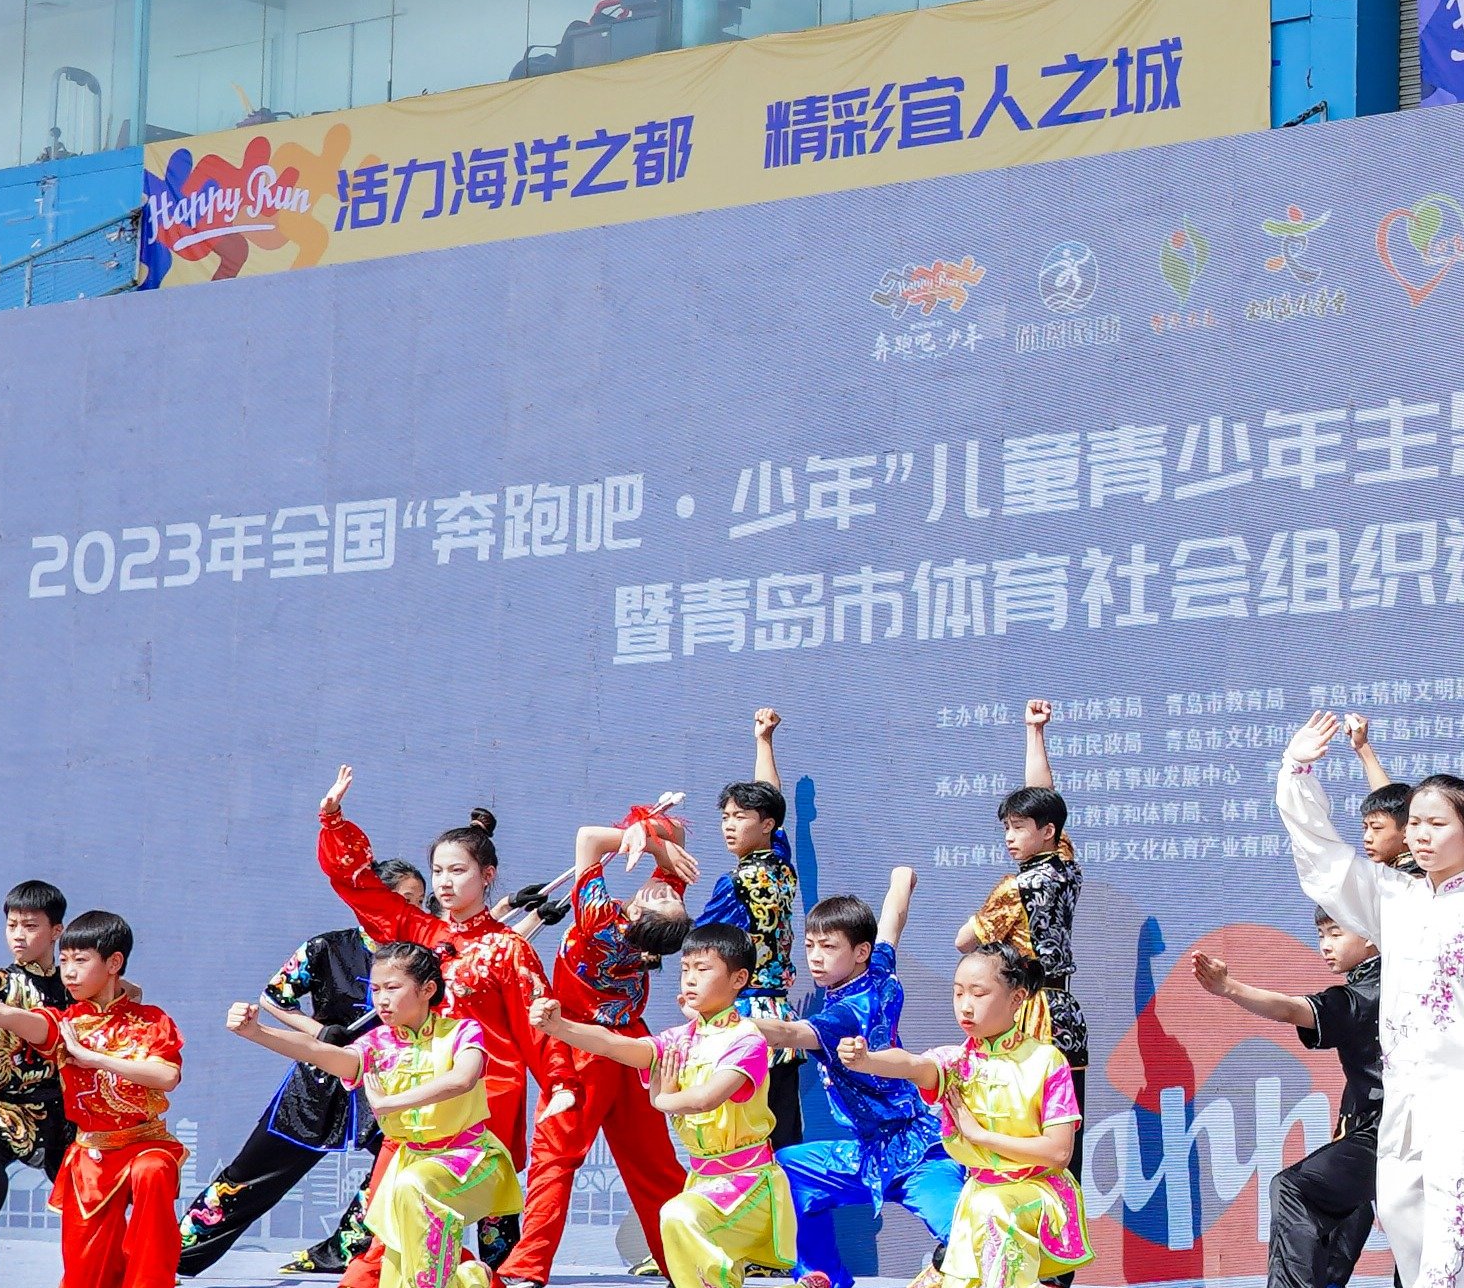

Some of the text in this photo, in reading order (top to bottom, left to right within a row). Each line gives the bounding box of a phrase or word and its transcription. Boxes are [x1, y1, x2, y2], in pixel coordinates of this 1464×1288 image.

[334, 37, 1186, 232] 活力海洋之都 精彩宜人之城
[147, 165, 312, 244] Happy Run
[1165, 687, 1285, 717] 青岛市教育局
[1047, 731, 1143, 758] 岛市民政局
